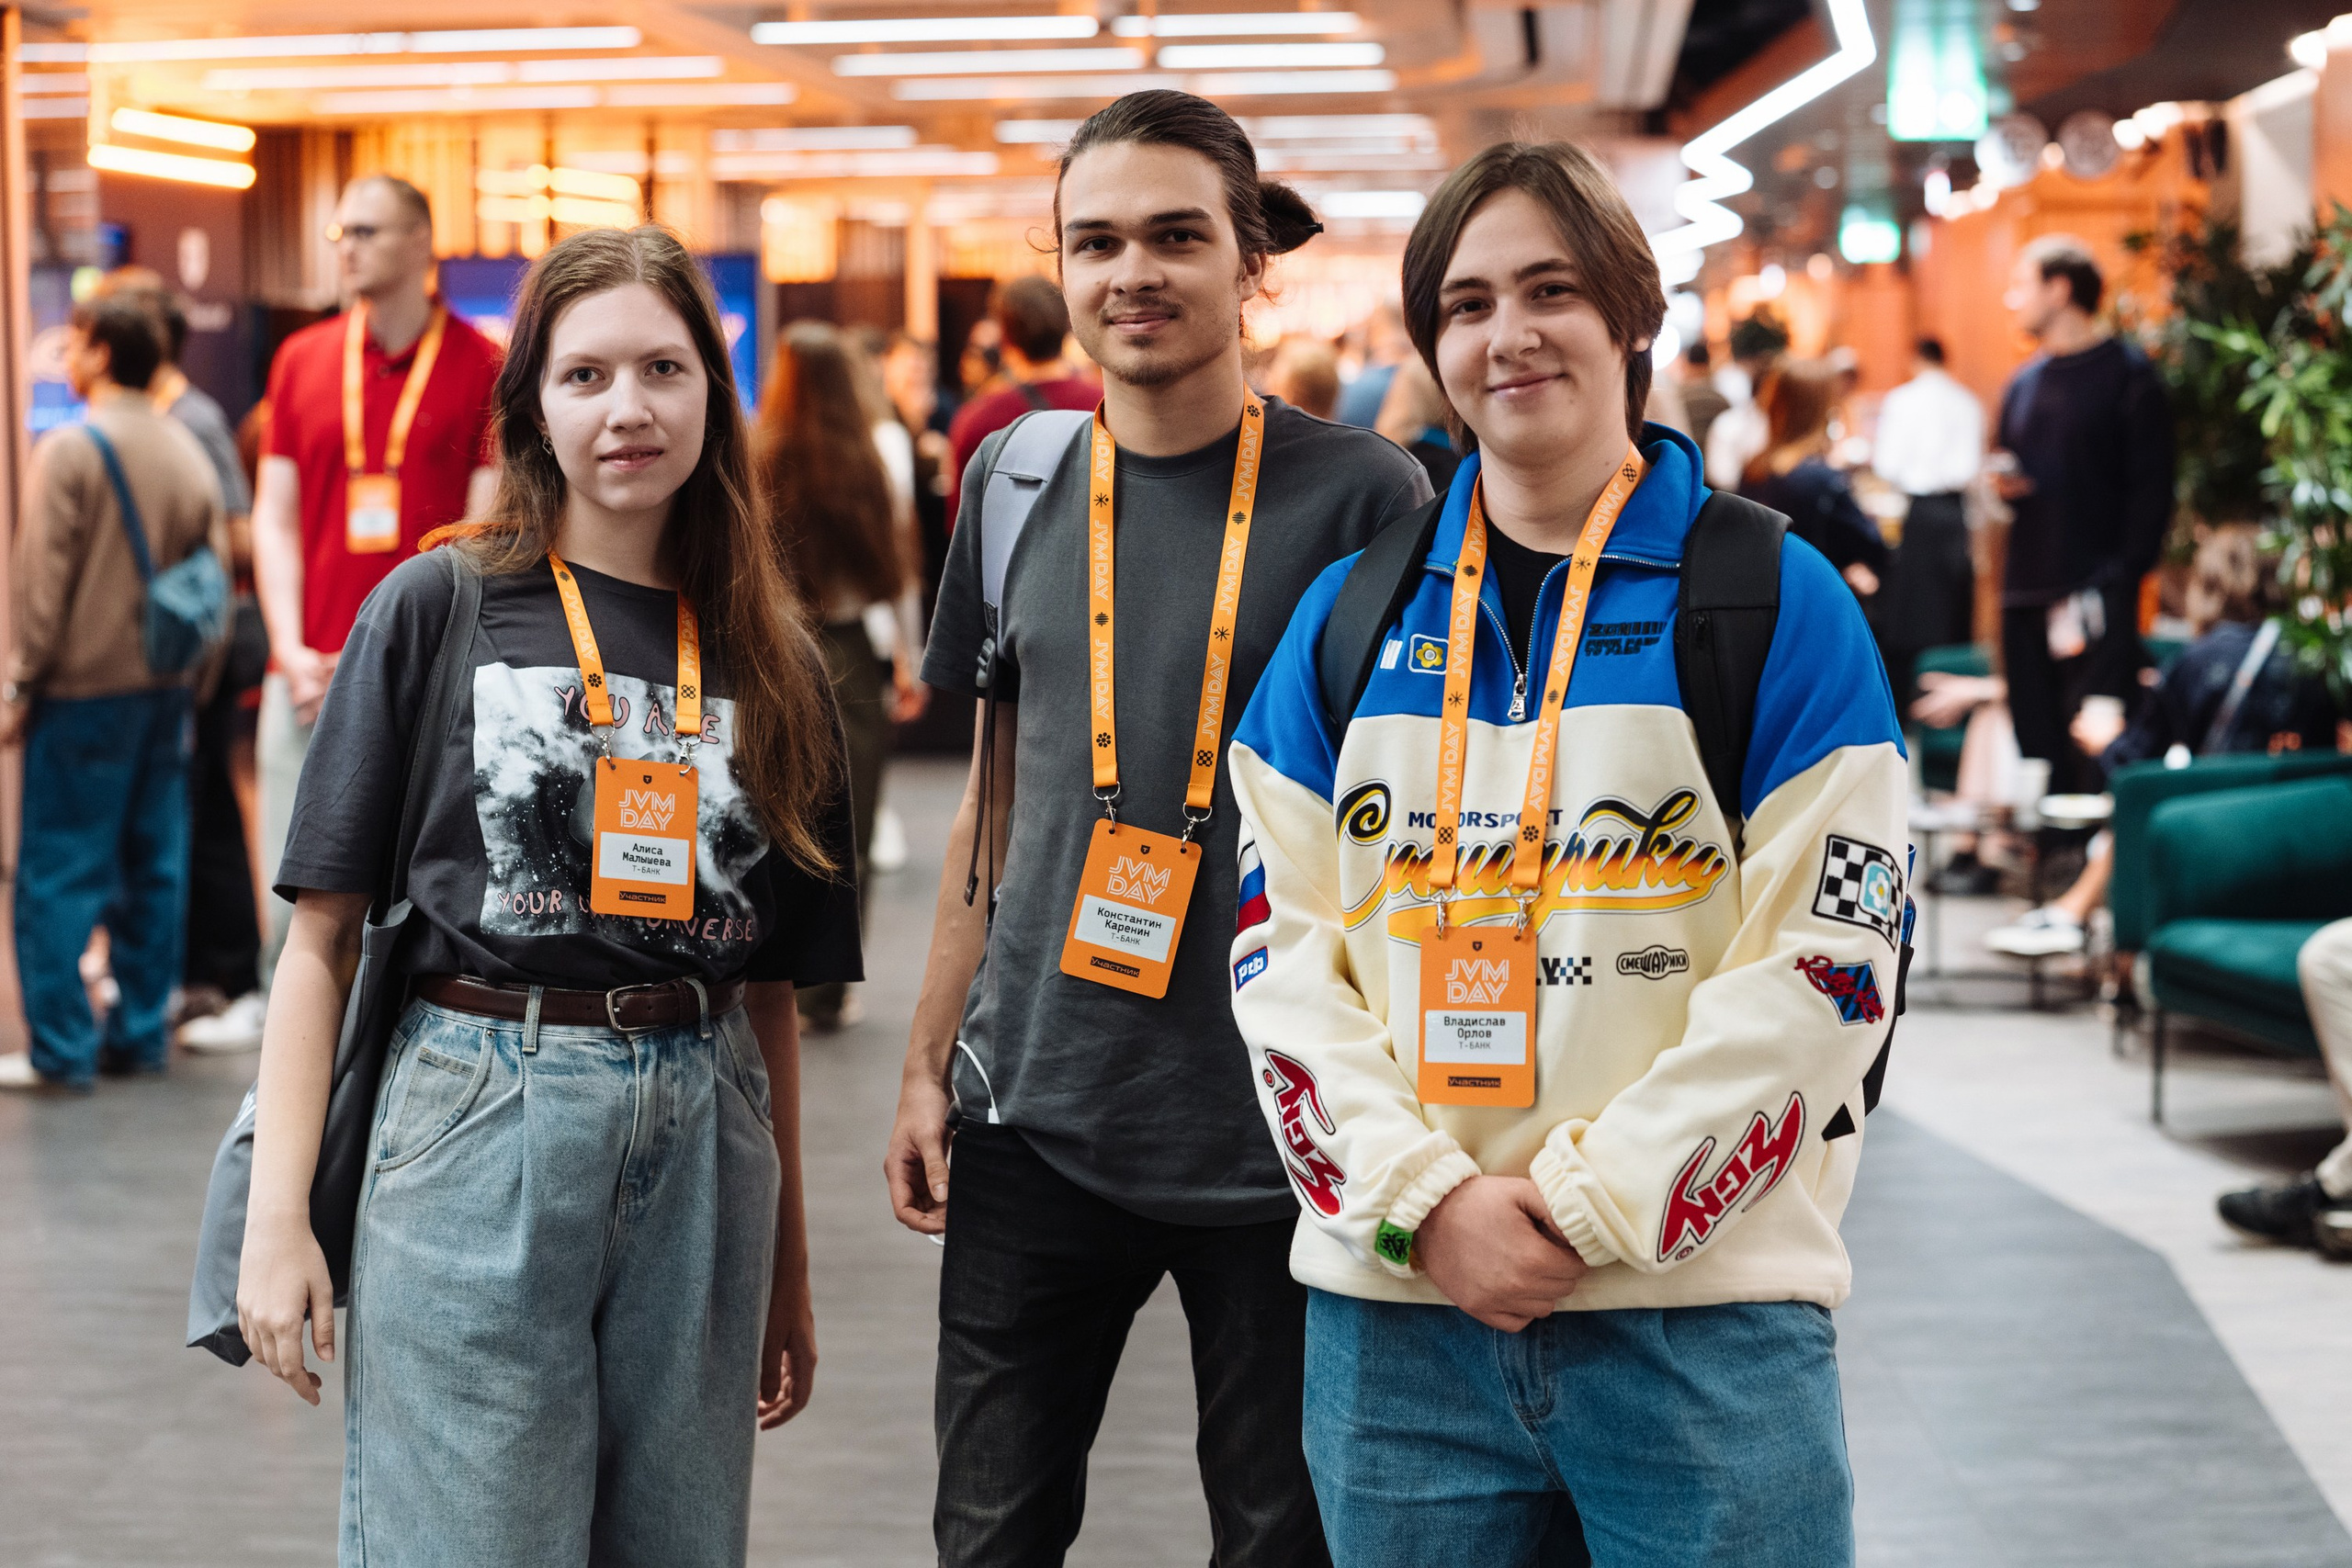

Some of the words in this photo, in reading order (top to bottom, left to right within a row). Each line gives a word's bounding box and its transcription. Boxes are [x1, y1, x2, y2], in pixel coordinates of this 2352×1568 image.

[1242, 424, 1259, 459] DAY
[1095, 446, 1110, 482] DAY
[1237, 462, 1254, 501] JVM
[1599, 482, 1624, 516] JVM
[1094, 520, 1109, 560] JVM
[1585, 513, 1610, 547] DAY
[1225, 536, 1242, 573] DAY
[1095, 563, 1109, 602] DAY
[1218, 575, 1237, 615] JVM
[1455, 589, 1474, 630] DAY
[1562, 584, 1583, 630] JVM
[564, 591, 585, 627] JVM
[576, 629, 596, 662] DAY
[1094, 638, 1109, 679] JVM
[1452, 633, 1469, 678] JVM
[1554, 635, 1573, 677] DAY
[1207, 652, 1226, 694] DAY
[554, 686, 630, 728] YU
[643, 701, 720, 744] AE
[1096, 682, 1110, 720] DAY
[1202, 696, 1220, 739] JVM
[1443, 720, 1461, 764] DAY
[1534, 718, 1554, 764] JVM
[618, 789, 675, 813] JVM
[1442, 767, 1458, 814] JVM
[1528, 767, 1547, 813] DAY
[620, 808, 674, 831] DAY
[622, 852, 672, 867] Малышева
[632, 843, 663, 856] Алиса
[632, 865, 661, 875] Т-БАНК
[1109, 855, 1171, 887] JVM
[497, 889, 563, 915] YOUR
[619, 891, 666, 903] Участник
[1106, 874, 1167, 905] DAY
[1097, 907, 1162, 930] Константин
[1104, 919, 1150, 937] Каренин
[1111, 932, 1141, 945] Т-БАНК
[1091, 957, 1140, 977] Участник
[1445, 959, 1510, 982] JVM
[1621, 951, 1687, 974] СМЕШАРИКИ
[1447, 981, 1509, 1004] DAY
[1443, 1016, 1506, 1027] Владислав
[1457, 1028, 1492, 1041] Орлов
[1459, 1042, 1491, 1050] Т-БАНК
[1448, 1077, 1501, 1088] Участник
